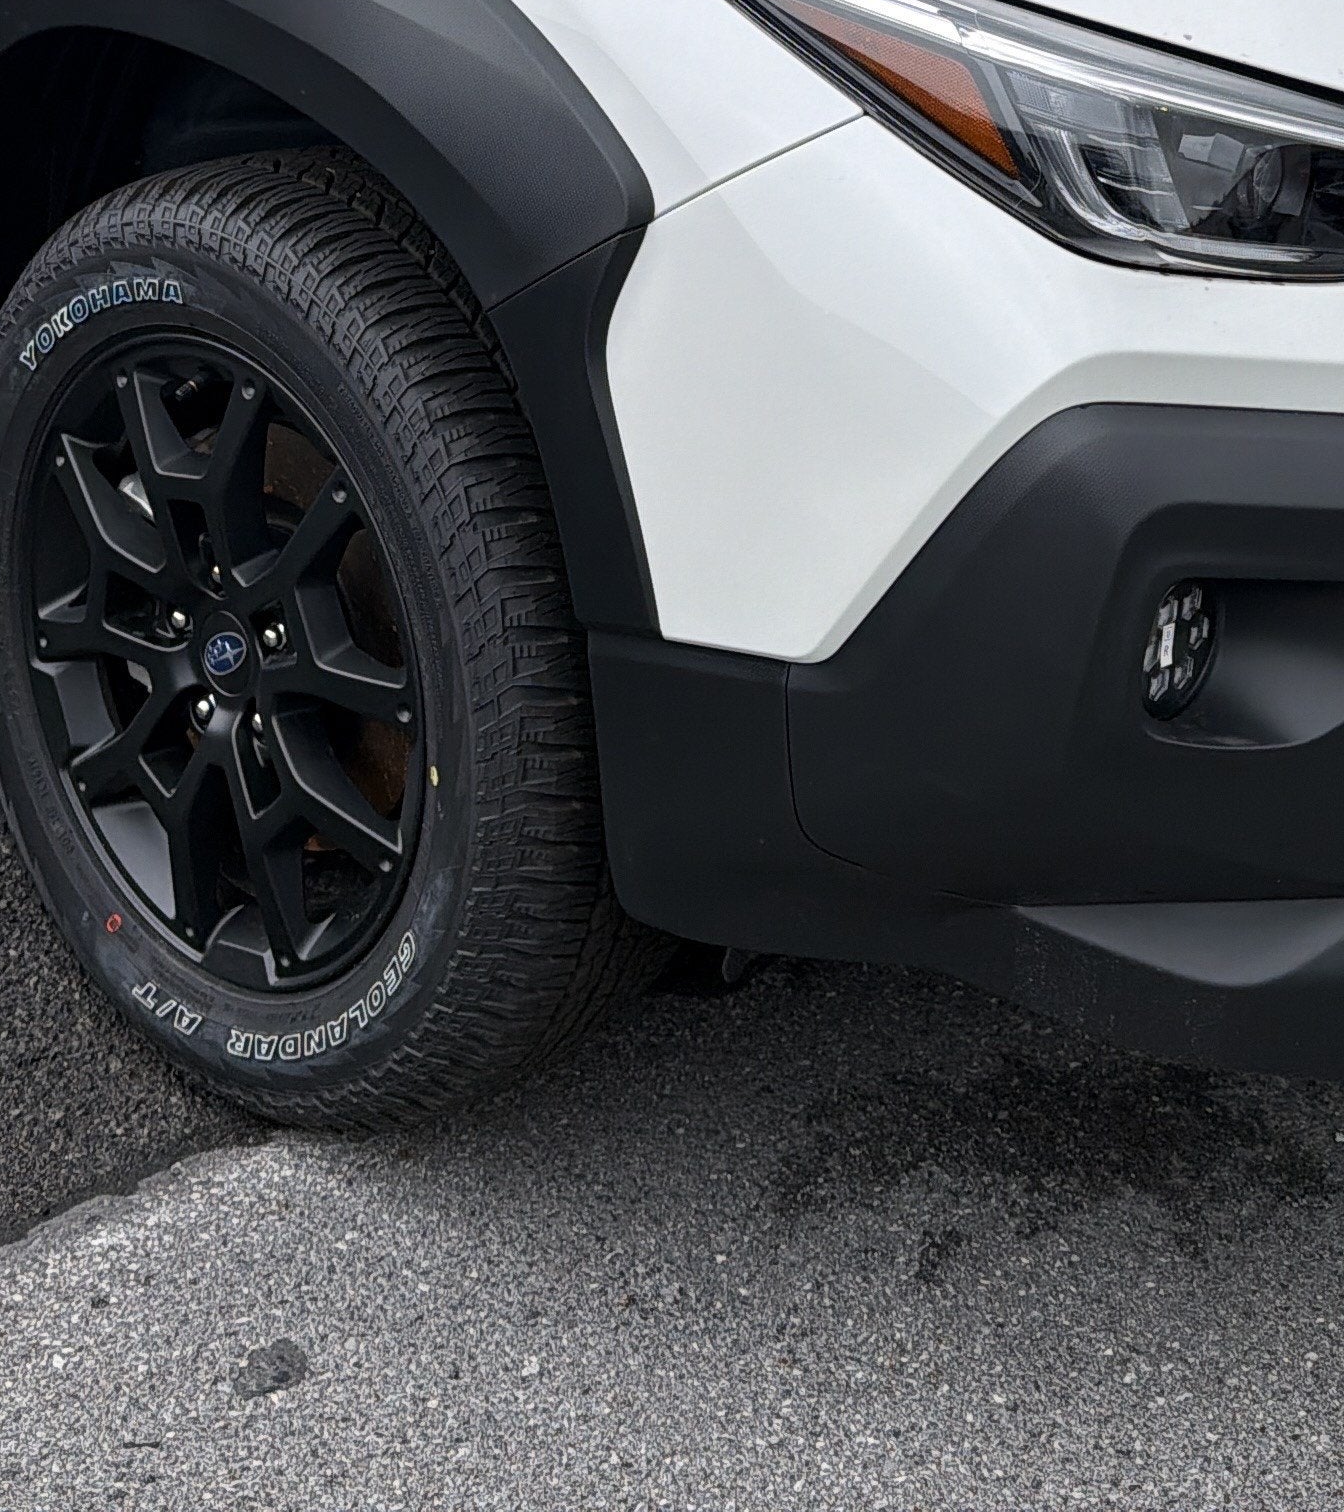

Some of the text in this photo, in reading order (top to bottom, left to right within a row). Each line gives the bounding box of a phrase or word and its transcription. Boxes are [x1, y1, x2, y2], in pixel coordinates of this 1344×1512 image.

[19, 278, 184, 372] YOKOHAMA
[131, 930, 417, 1061] GEOLANDAR A/T
